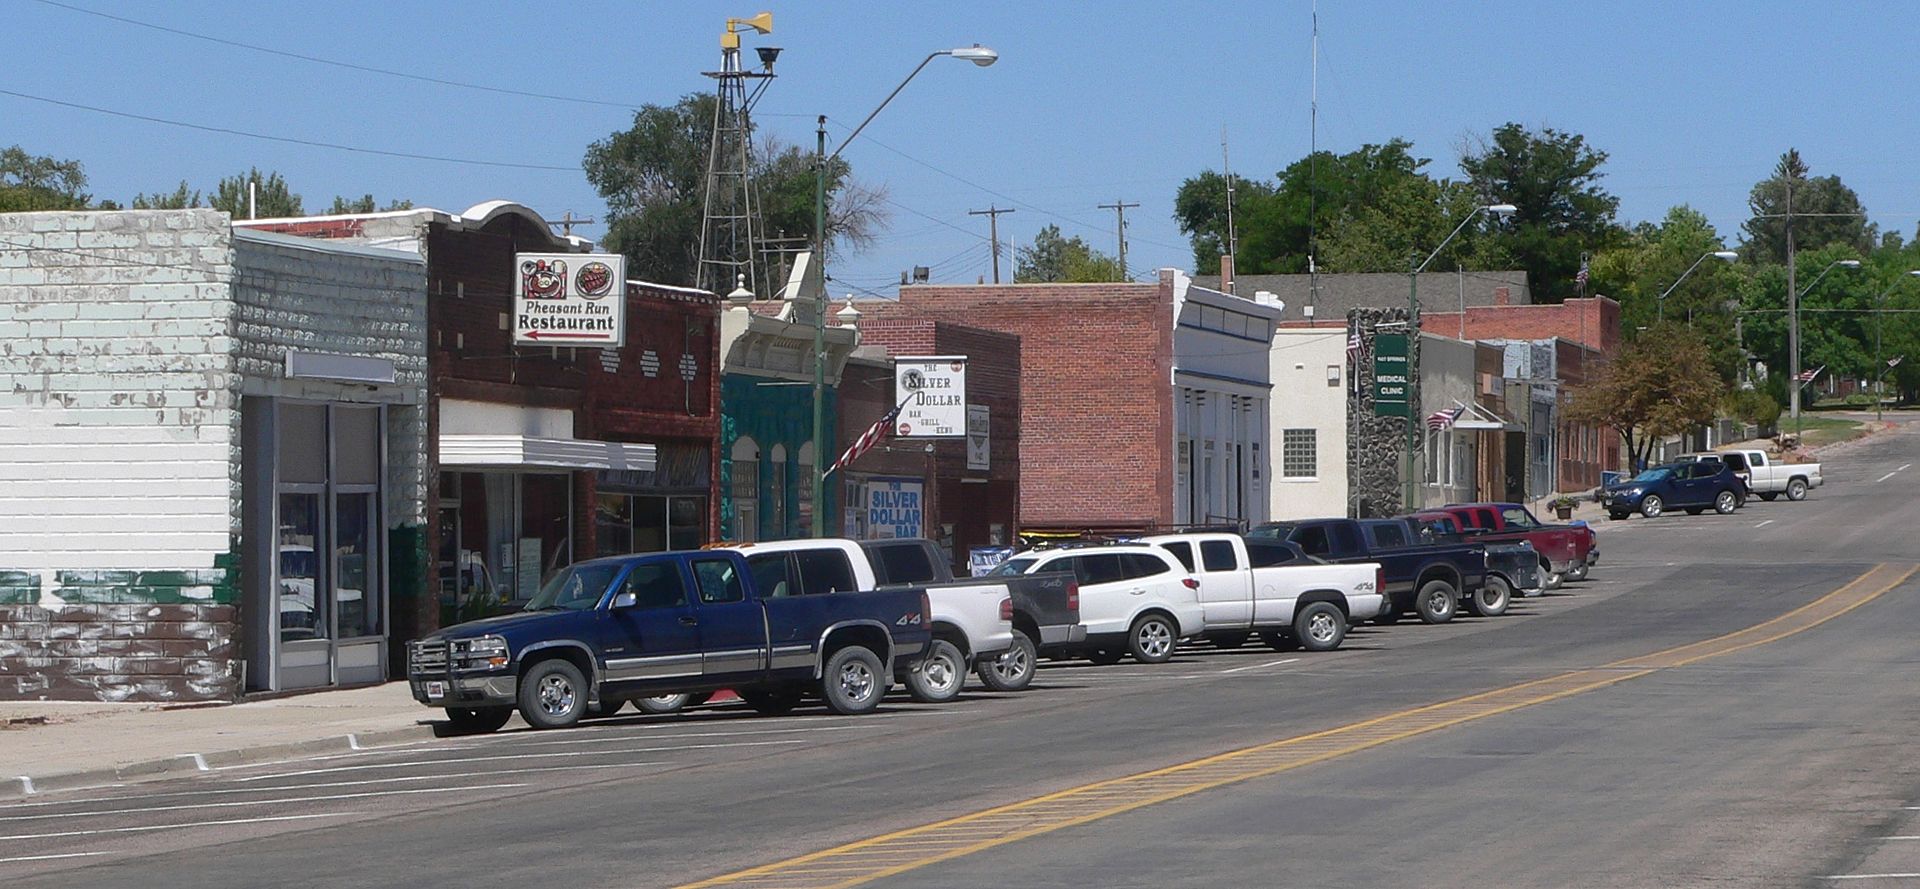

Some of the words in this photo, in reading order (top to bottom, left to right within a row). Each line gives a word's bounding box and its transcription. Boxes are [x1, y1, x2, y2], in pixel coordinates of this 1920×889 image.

[525, 301, 582, 315] Pheasant
[585, 301, 610, 315] Run
[518, 315, 614, 330] Restaurant
[924, 364, 937, 372] THE
[908, 373, 951, 389] SILVER
[1377, 375, 1407, 383] MEDICAL
[1380, 386, 1404, 395] CLINIC
[916, 391, 962, 406] DOLLAR
[909, 410, 921, 418] BAR
[889, 481, 902, 491] THE
[872, 491, 918, 508] SILVER
[870, 509, 920, 525] DOLLAR
[895, 526, 917, 538] BAR
